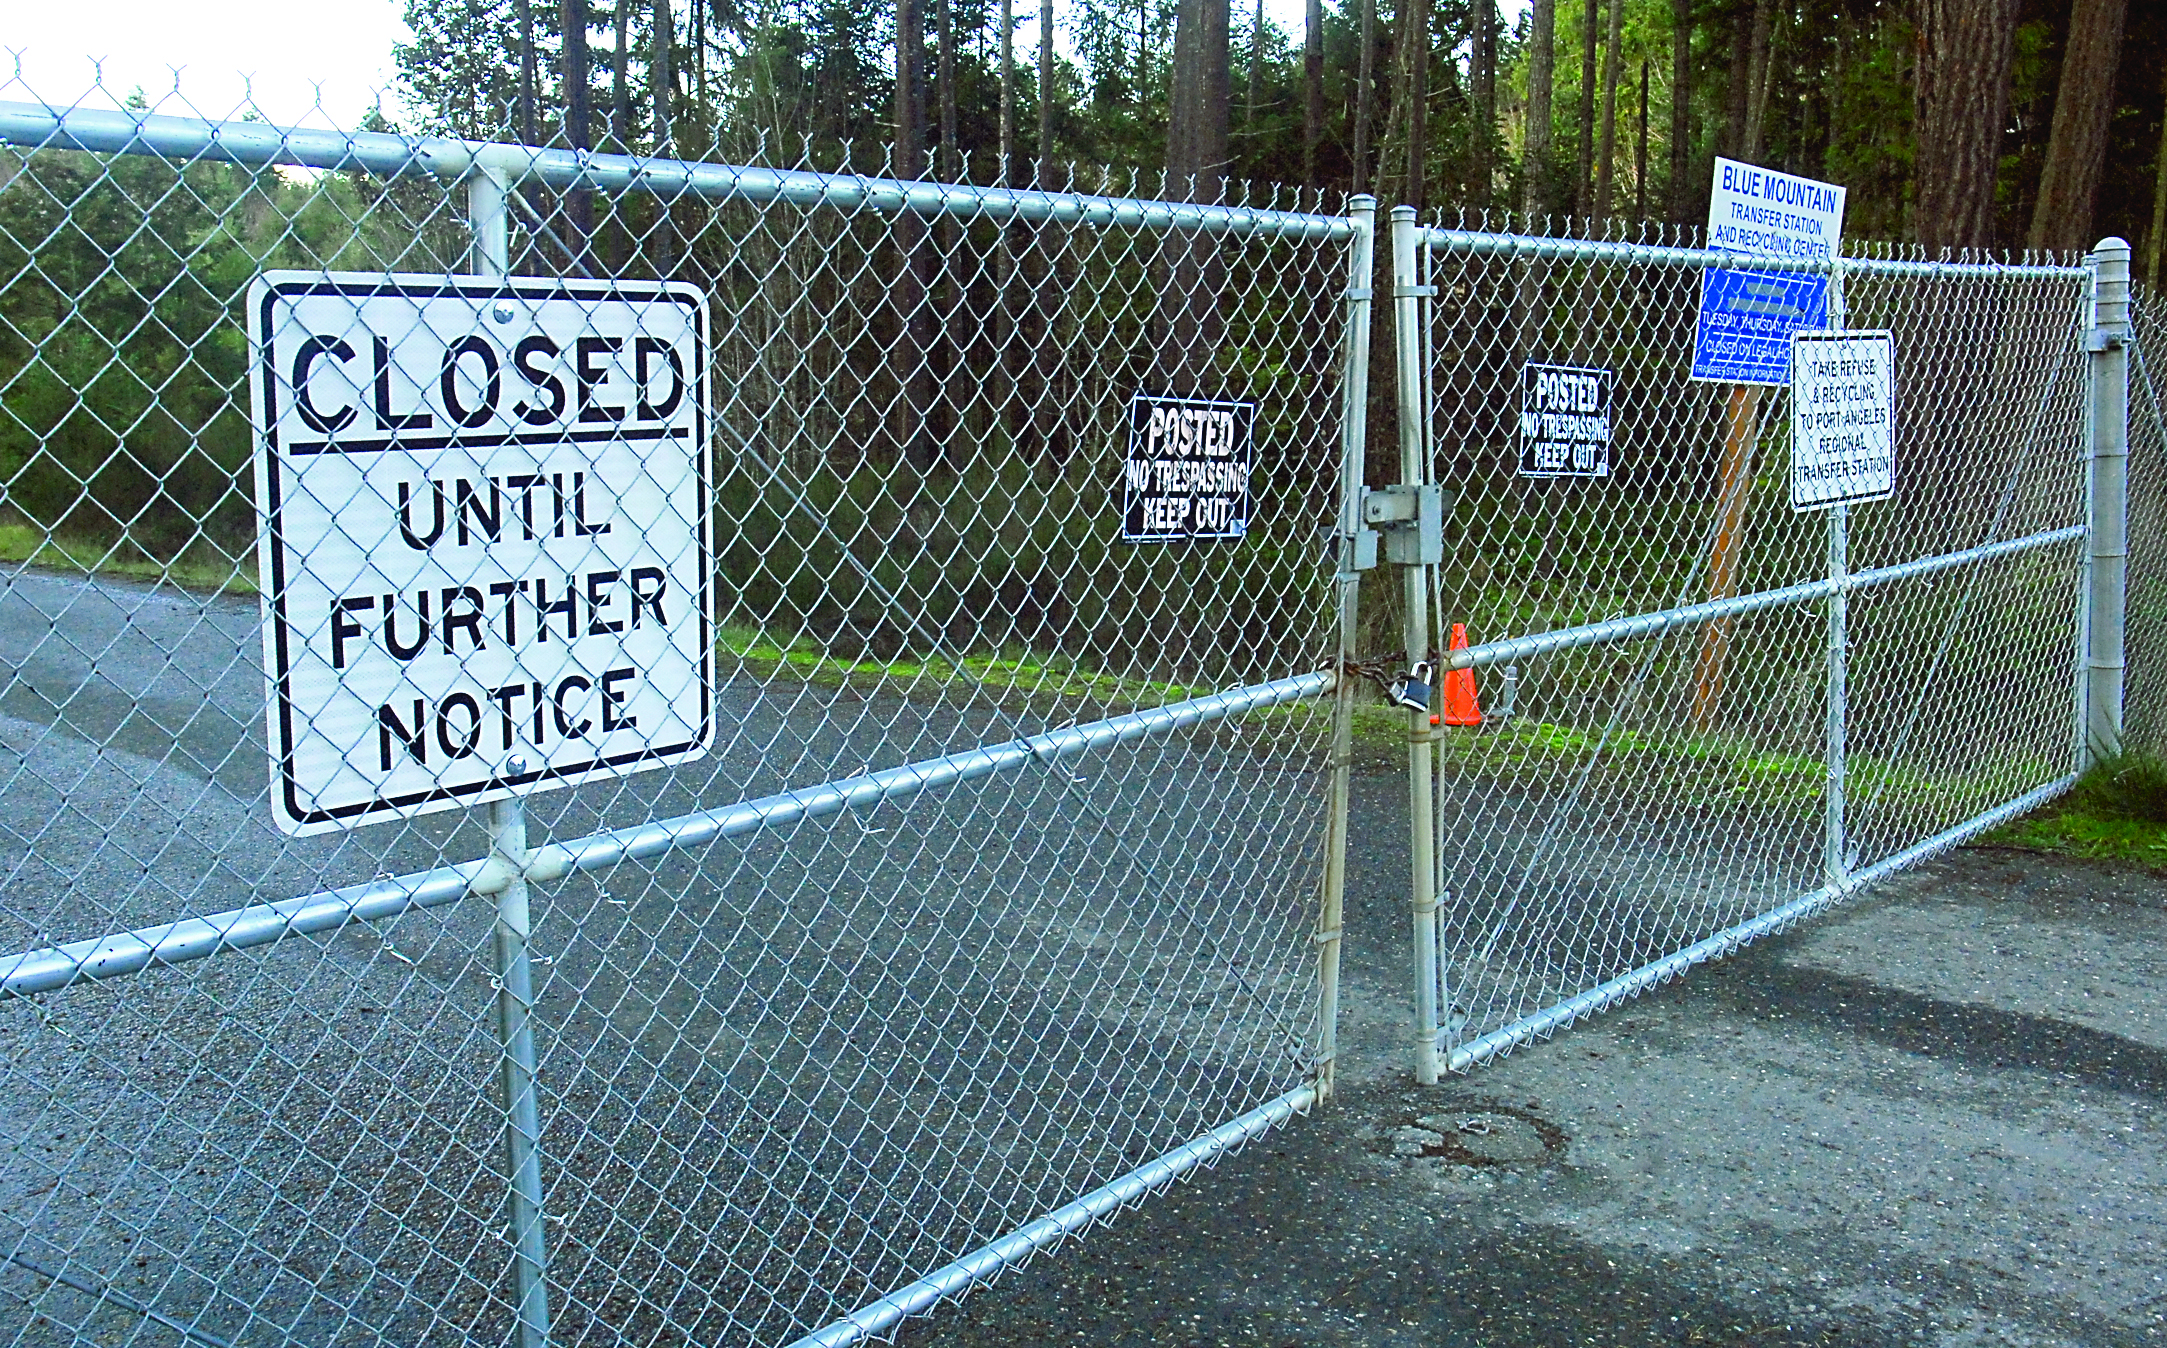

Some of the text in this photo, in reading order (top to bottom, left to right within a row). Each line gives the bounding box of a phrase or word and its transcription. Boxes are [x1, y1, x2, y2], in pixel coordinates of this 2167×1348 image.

[1722, 165, 1837, 214] BLUE MOUNTAIN
[1731, 202, 1823, 236] TRANSFER STATION
[1715, 224, 1831, 258] AND RECYCLING CENTER
[1702, 311, 1739, 329] TUESDAY,
[1706, 339, 1738, 355] CLOSED
[292, 334, 684, 433] CLOSED
[1812, 358, 1875, 378] TAKE REFUSE
[1536, 371, 1599, 413] POSTED
[1813, 383, 1875, 404] & RECYCLING
[1147, 407, 1234, 457] POSTED
[1521, 411, 1608, 442] NO TRESPASSING
[1800, 407, 1886, 430] TO PORT ANGELES
[1533, 442, 1597, 470] KEEP OUT
[1819, 434, 1867, 455] REGIONAL
[1128, 459, 1247, 493] NO TRESPASSING
[1797, 455, 1889, 483] TRANSFER STATION
[398, 471, 611, 551] UNTIL
[1142, 497, 1230, 529] KEEP OUT
[330, 566, 669, 669] FURTHER
[379, 667, 637, 772] NOTICE
